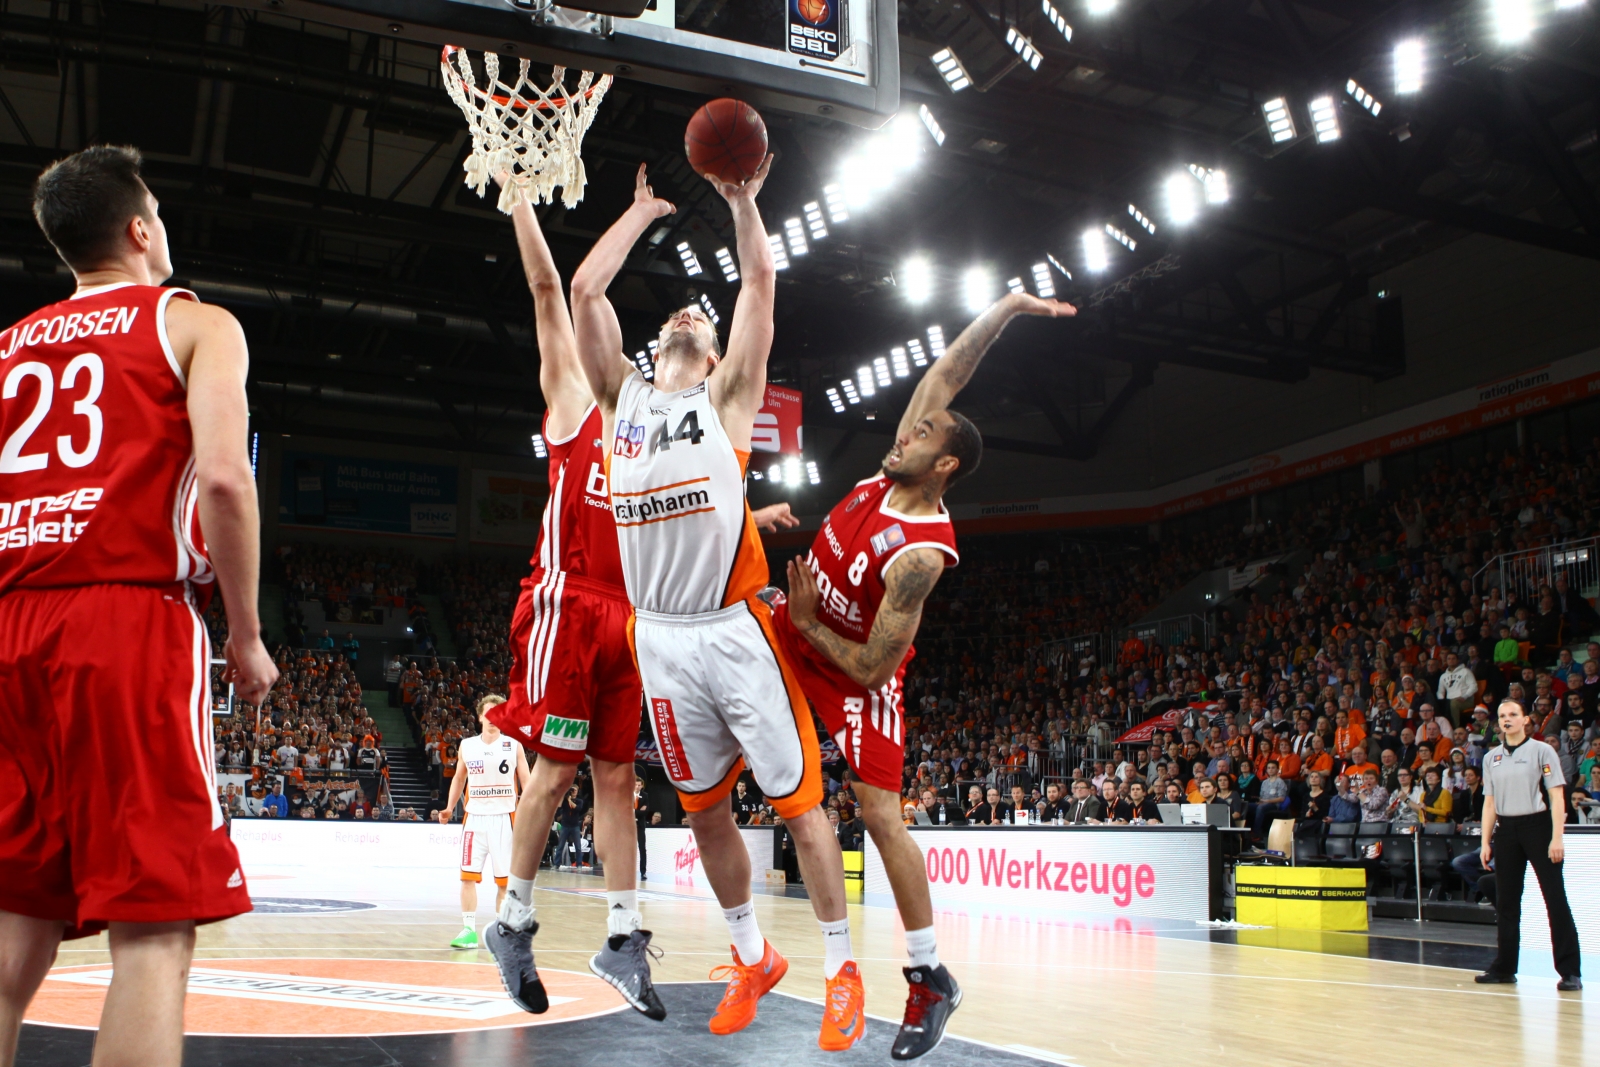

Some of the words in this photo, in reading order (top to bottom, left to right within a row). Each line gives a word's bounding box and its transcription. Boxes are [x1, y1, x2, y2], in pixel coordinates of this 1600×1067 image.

[790, 23, 837, 43] BEKO
[790, 34, 837, 56] BBL
[0, 307, 139, 360] JACOBSEN
[768, 388, 800, 403] Sparkasse
[1479, 371, 1549, 402] ratiopharm
[768, 398, 782, 408] Ulm
[1481, 406, 1511, 424] MAX
[1515, 395, 1550, 414] BÖGL
[0, 352, 105, 474] 23
[1390, 435, 1415, 450] MAX
[1418, 423, 1450, 441] BÖGL
[337, 465, 357, 476] Mit
[360, 467, 381, 479] Bus
[384, 469, 406, 481] und
[409, 471, 438, 484] Bahn
[1295, 463, 1318, 477] MAX
[1320, 455, 1348, 469] BÖGL
[336, 477, 386, 493] bequem
[387, 483, 405, 493] zur
[407, 483, 441, 496] Arena
[1225, 484, 1246, 497] MAX
[981, 502, 1039, 515] ratiopharm
[824, 523, 845, 561] MARSH
[848, 551, 868, 586] 8
[498, 759, 510, 775] 6
[470, 788, 513, 797] ratiopharm
[235, 829, 282, 845] Rehaplus
[335, 831, 381, 846] Rehaplus
[926, 847, 970, 885] 000
[978, 848, 1156, 907] Werkzeuge
[1237, 886, 1275, 894] EBERHARDT
[1277, 888, 1319, 897] EBERHARDT
